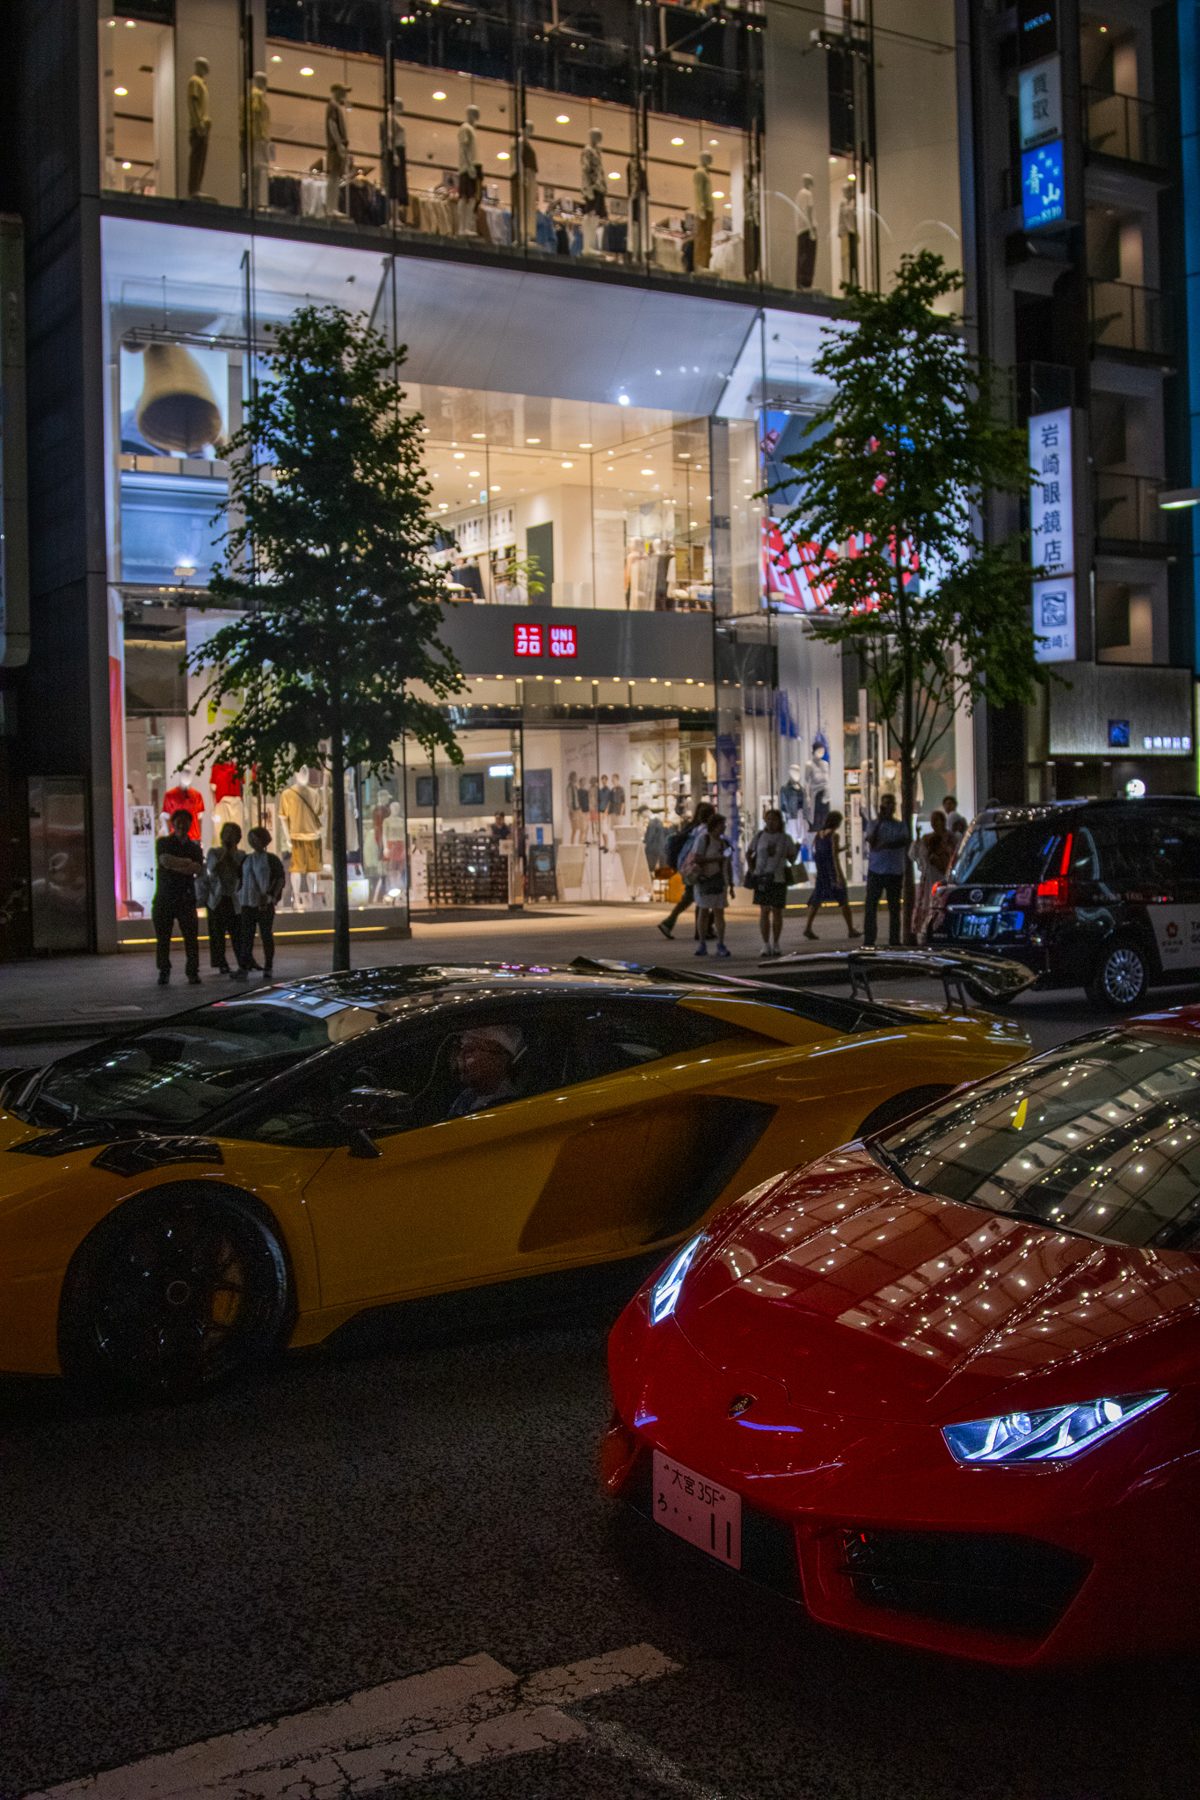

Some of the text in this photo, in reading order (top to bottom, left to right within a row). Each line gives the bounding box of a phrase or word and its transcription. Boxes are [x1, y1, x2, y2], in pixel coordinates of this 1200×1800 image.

[1041, 423, 1062, 562] 岩崎眼鏡店
[551, 628, 573, 641] UNI
[551, 641, 575, 656] QLO
